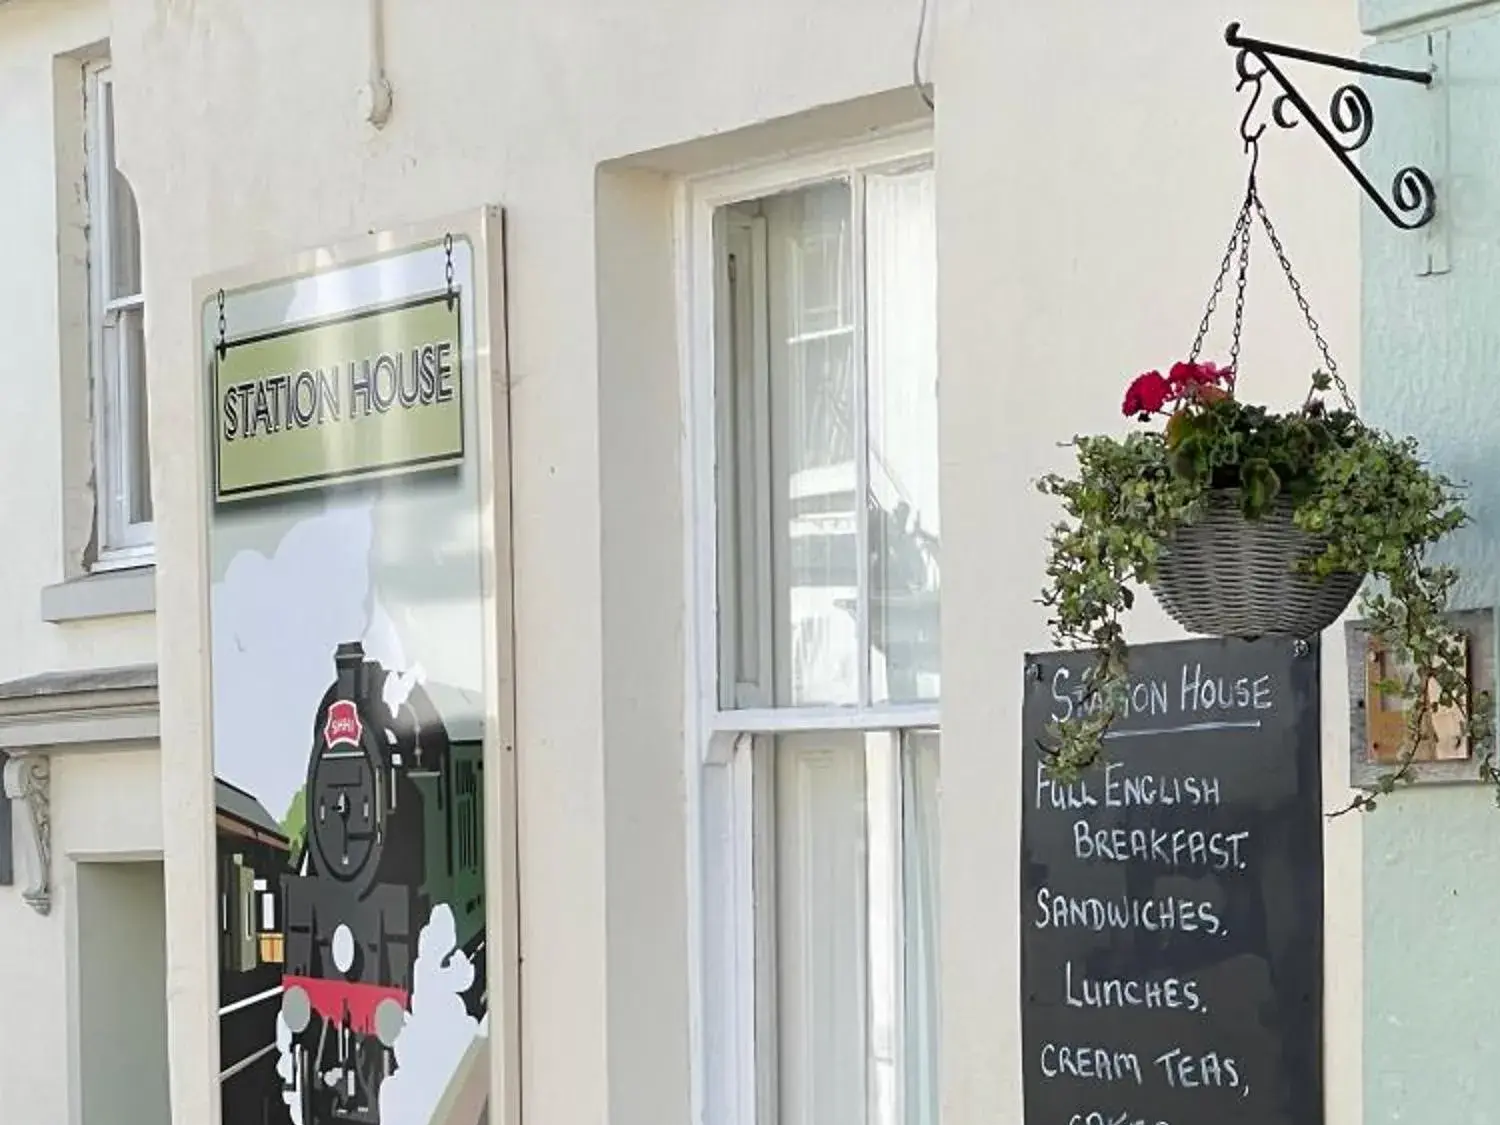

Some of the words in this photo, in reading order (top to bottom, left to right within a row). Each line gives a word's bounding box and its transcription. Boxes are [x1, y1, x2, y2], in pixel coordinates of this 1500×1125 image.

[224, 365, 340, 441] STATION
[350, 343, 454, 418] HOUSE
[1180, 664, 1273, 712] HOUSE
[1104, 762, 1220, 807] ENGLISH
[1073, 820, 1250, 869] BREAKFAST.
[1041, 1044, 1143, 1085] CREAM
